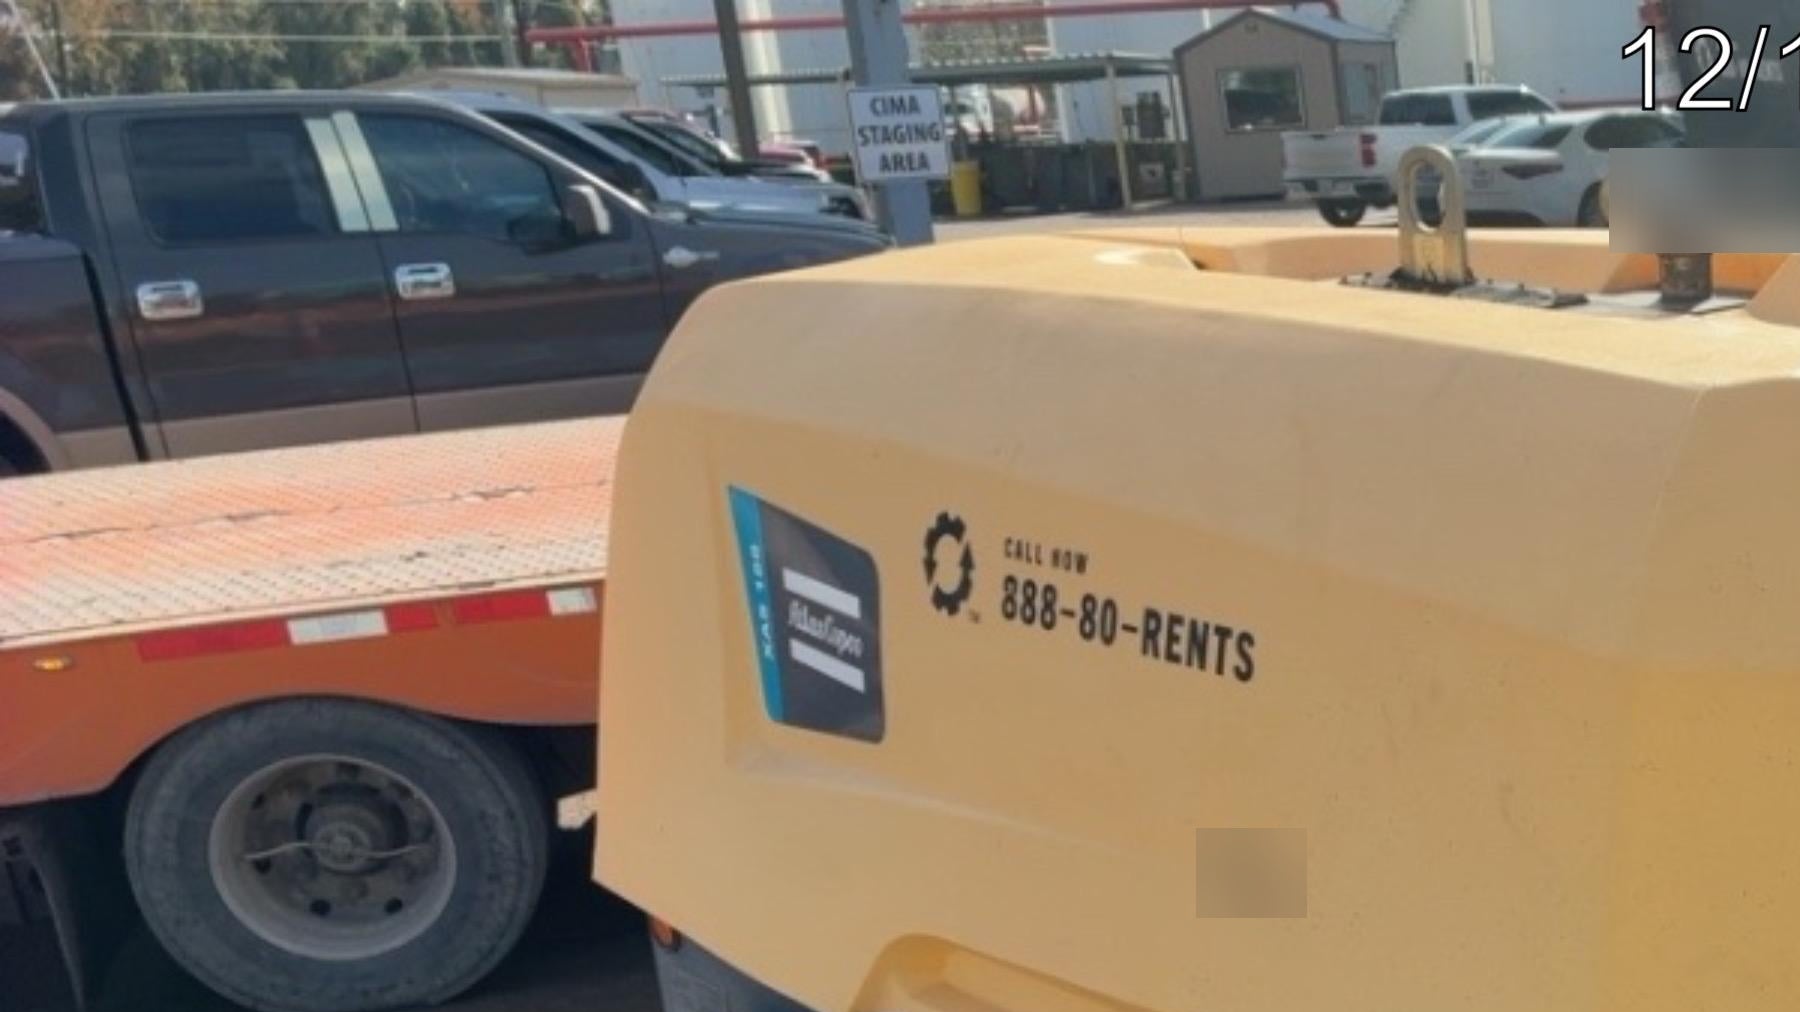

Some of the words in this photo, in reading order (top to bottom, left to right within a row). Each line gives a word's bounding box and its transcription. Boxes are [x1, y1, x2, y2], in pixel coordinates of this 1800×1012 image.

[869, 95, 921, 117] CIMA
[857, 122, 940, 146] STAGING
[879, 152, 931, 172] AREA
[1004, 536, 1043, 565] CALL
[1051, 548, 1089, 575] NOW
[1000, 574, 1255, 682] 888-80-RENTS
